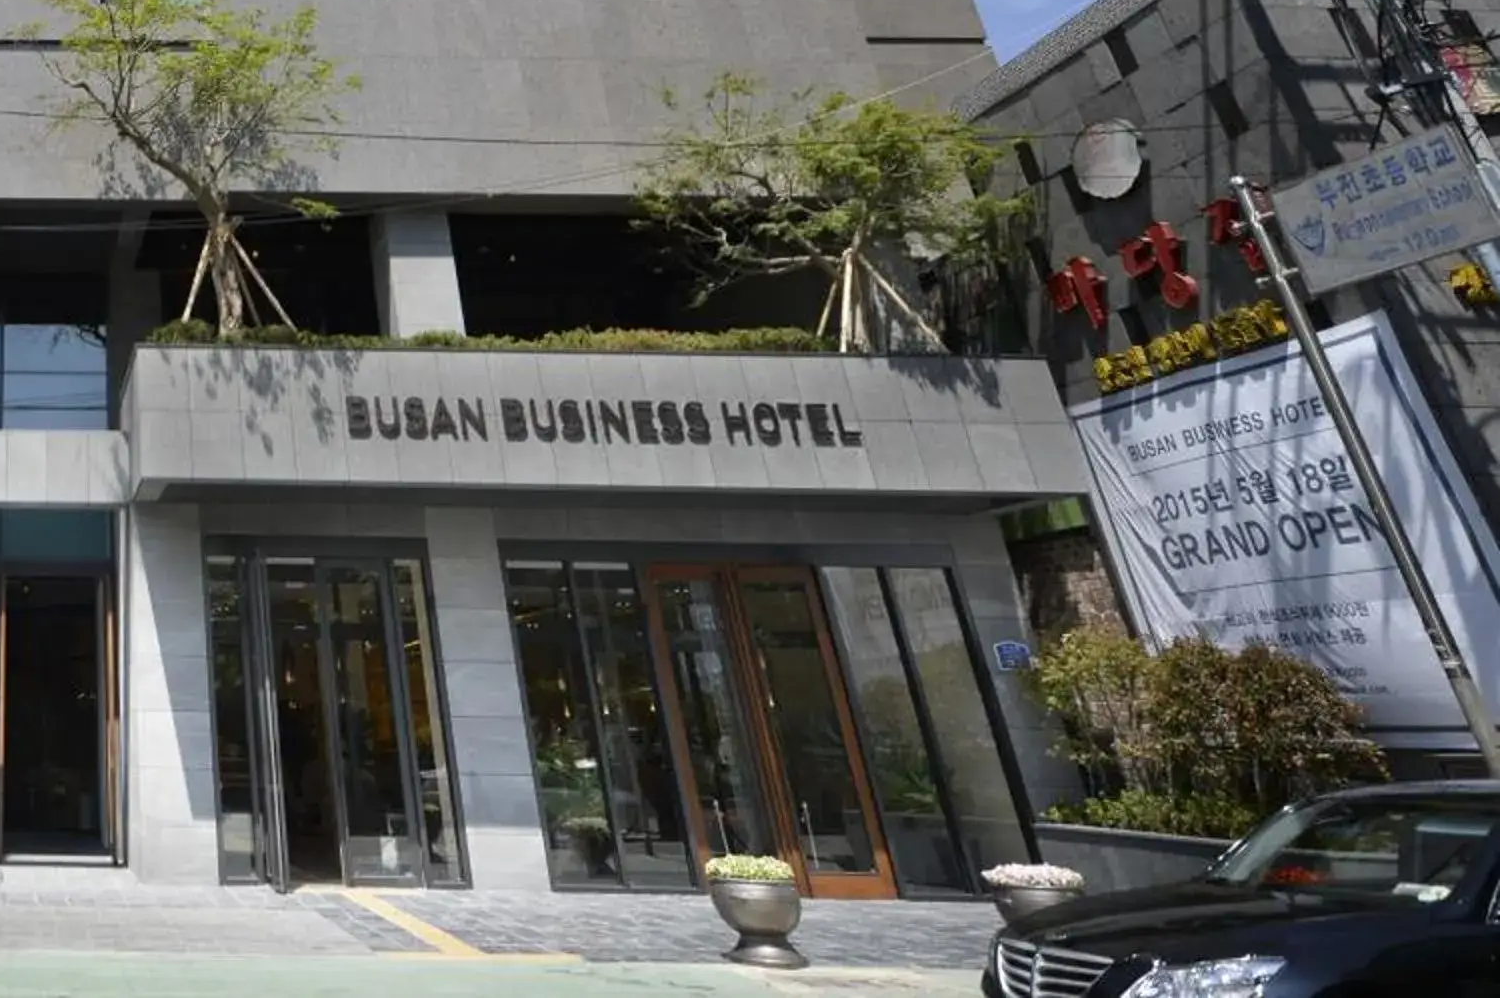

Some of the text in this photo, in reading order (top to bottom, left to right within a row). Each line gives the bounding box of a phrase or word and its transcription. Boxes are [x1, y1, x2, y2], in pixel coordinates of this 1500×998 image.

[1315, 134, 1457, 211] 부전초등학교
[346, 395, 863, 449] BUSAN BUSINESS HOTEL
[1126, 395, 1326, 462] BUSAN BUSINESS HOTE
[1150, 454, 1355, 526] 2015년 5월 18일
[1160, 501, 1388, 571] GRAND OPEN
